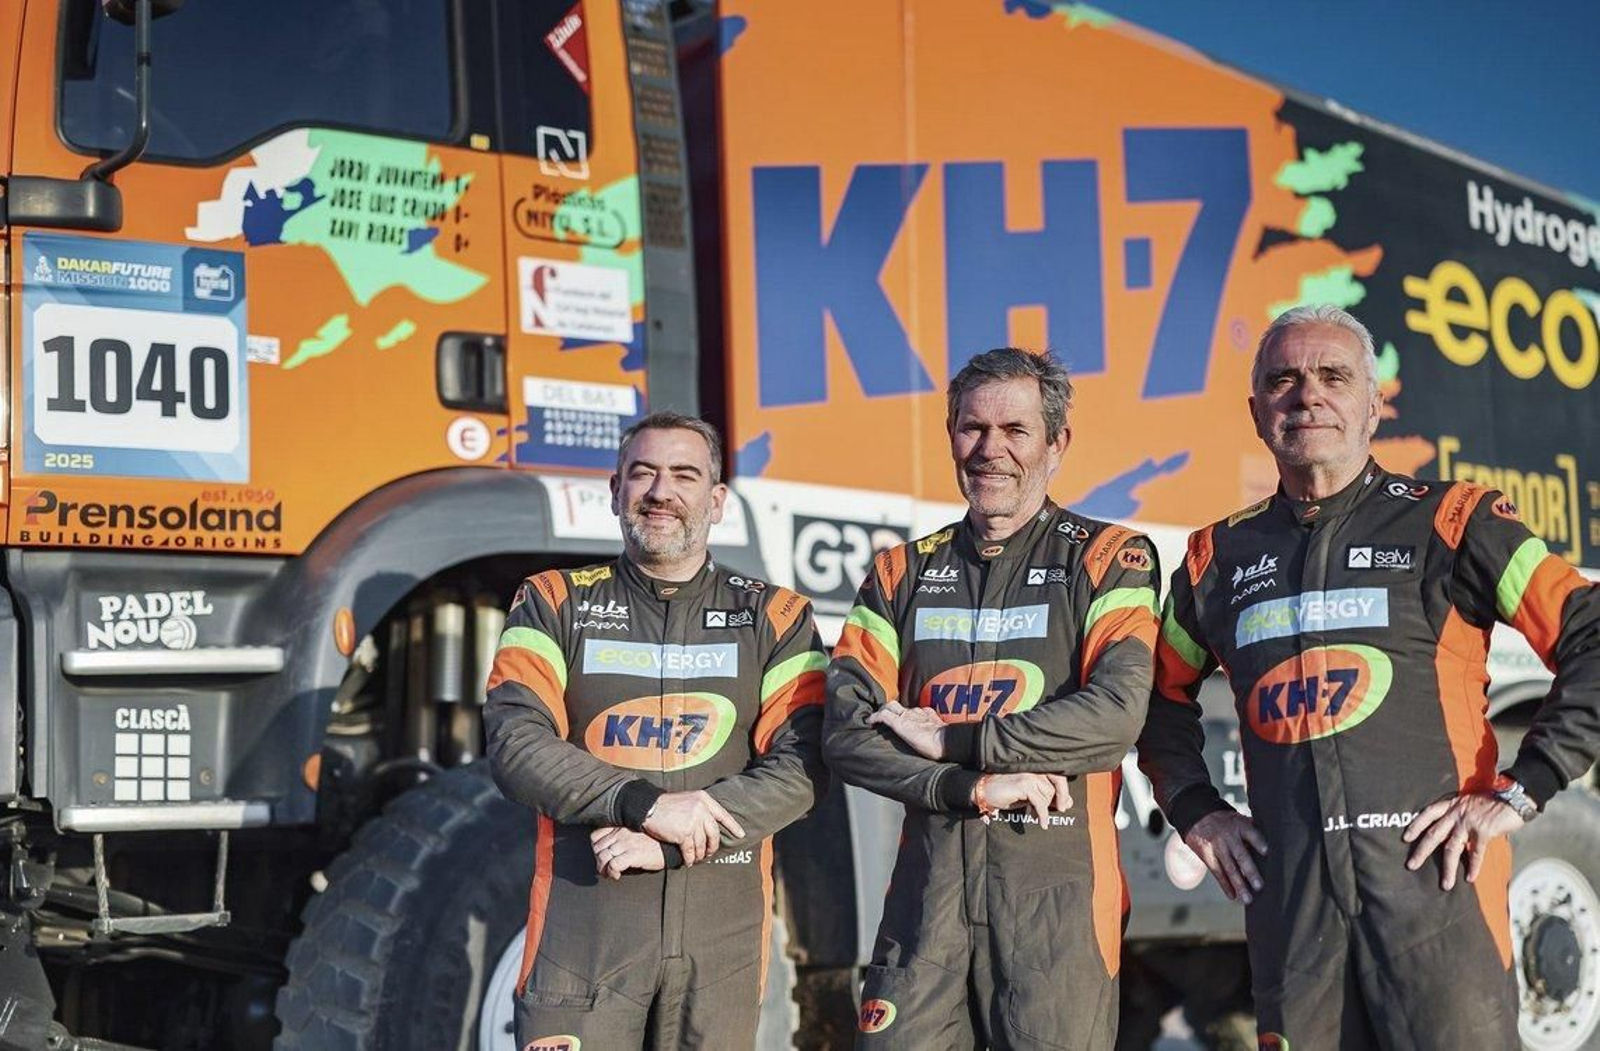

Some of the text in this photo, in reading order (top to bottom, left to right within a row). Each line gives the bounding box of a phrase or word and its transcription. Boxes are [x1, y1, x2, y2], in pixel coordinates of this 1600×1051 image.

[330, 158, 369, 182] JORDI
[751, 126, 1253, 409] KH-7
[42, 335, 229, 420] 1040
[44, 453, 94, 469] 2025
[22, 490, 283, 532] Prensoland
[20, 531, 283, 549] BUILDING ORIGINS
[98, 591, 213, 621] PADEL
[86, 618, 161, 650] NOU
[594, 646, 728, 671] ecoVERGY
[929, 678, 1018, 715] KH-7
[1258, 667, 1359, 725] KH-7
[115, 704, 191, 731] CLASCÀ
[602, 712, 709, 754] KH-7
[1004, 813, 1076, 826] JUVATENY
[1356, 811, 1420, 829] CRIAD
